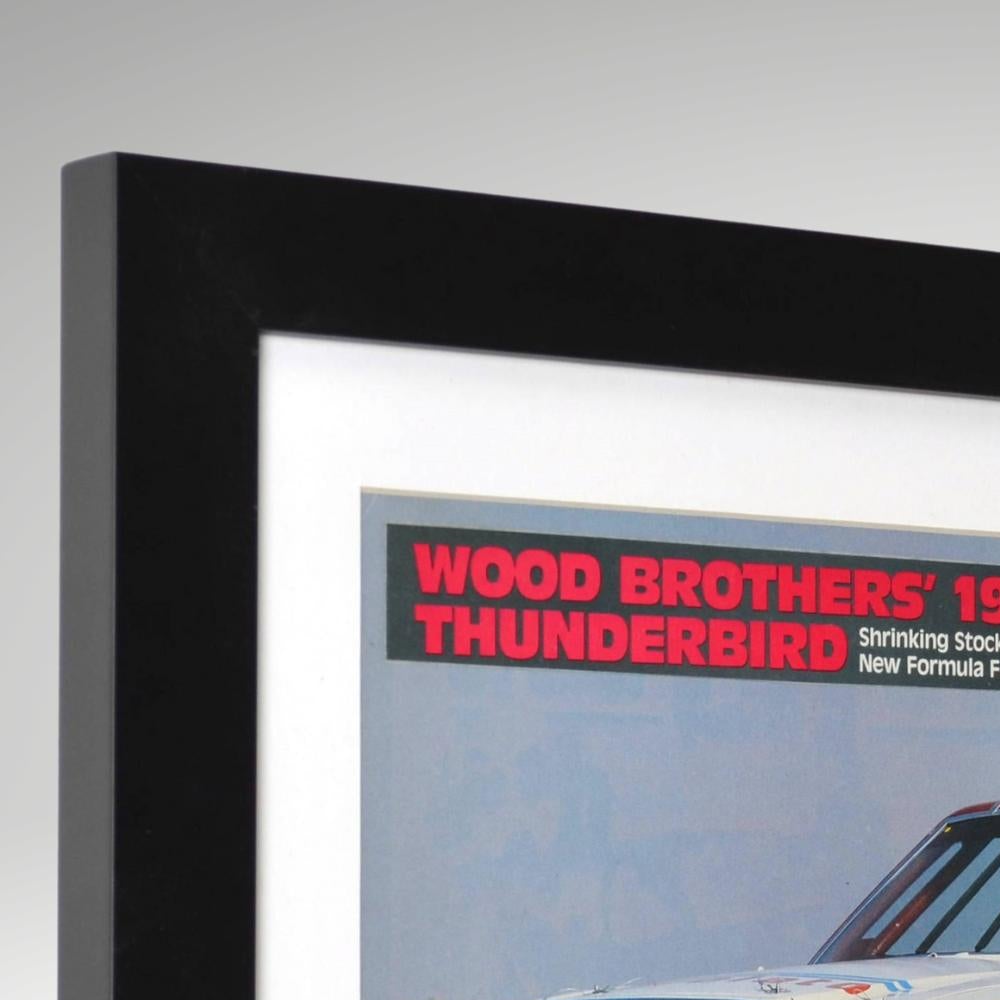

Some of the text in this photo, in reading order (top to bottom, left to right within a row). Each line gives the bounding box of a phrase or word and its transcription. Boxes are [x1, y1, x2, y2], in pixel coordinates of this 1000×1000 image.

[413, 543, 602, 601] WOOD
[415, 604, 848, 673] THUNDERBIRD
[858, 626, 949, 652] Shrinking
[858, 653, 901, 674] New
[906, 655, 985, 678] Formula
